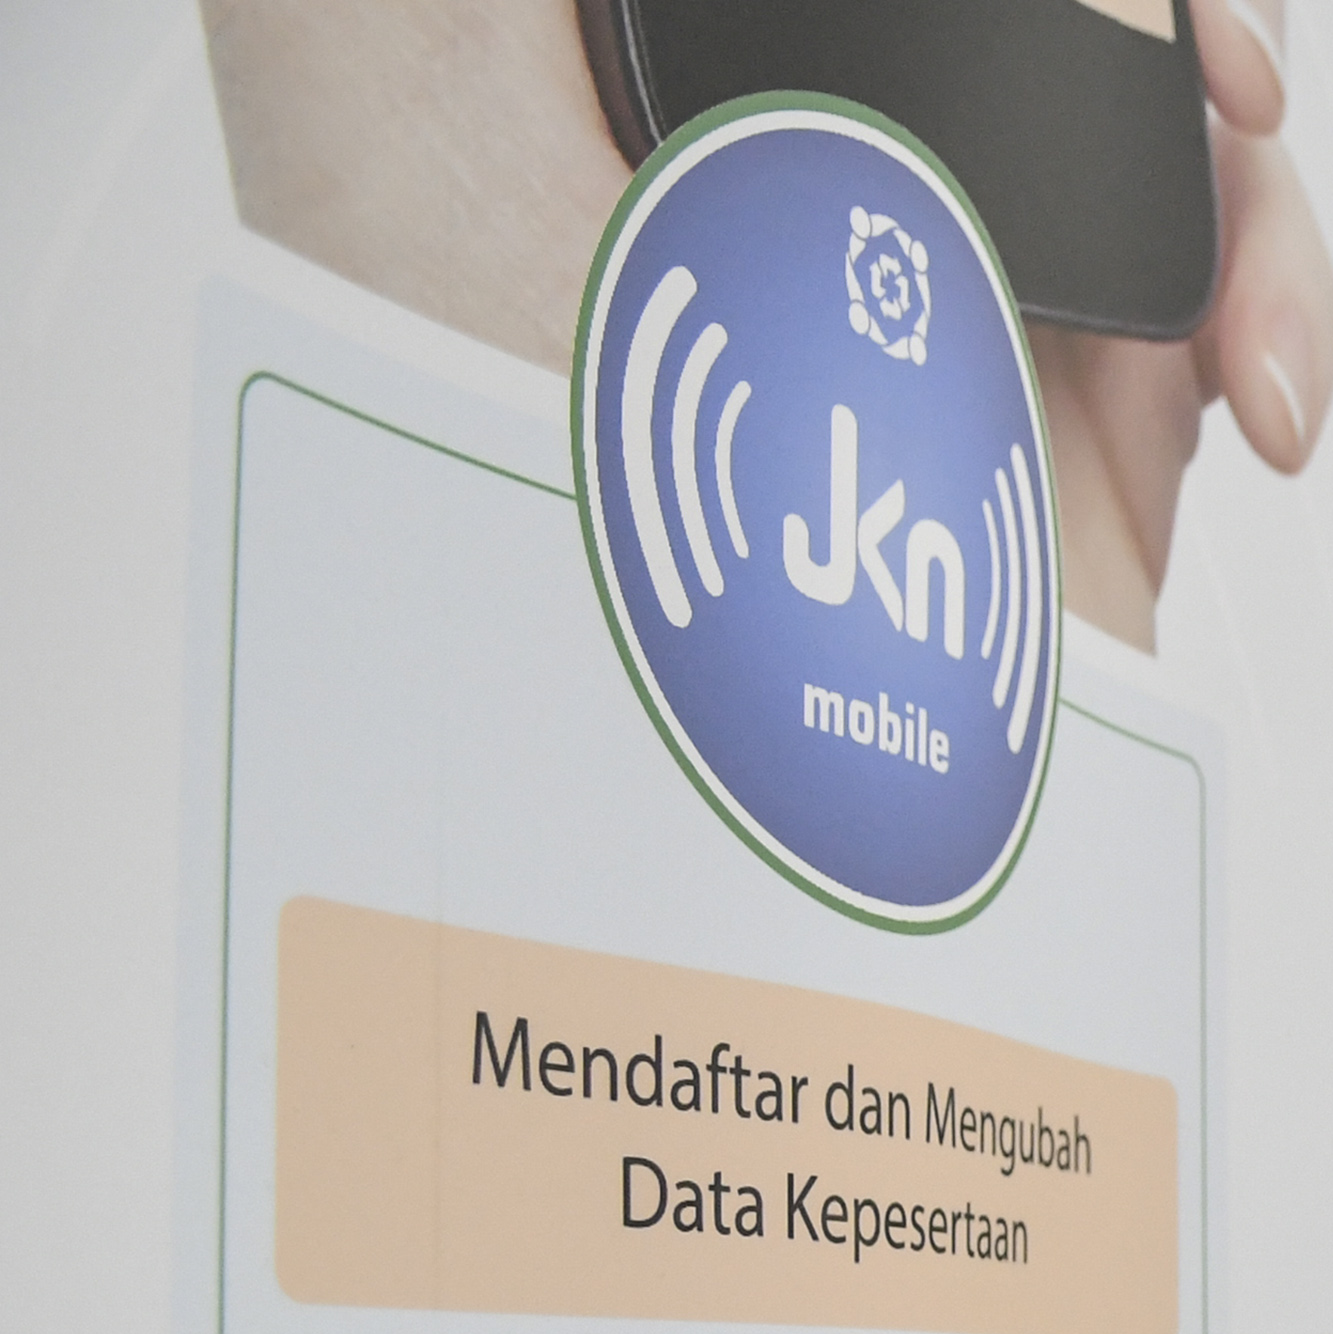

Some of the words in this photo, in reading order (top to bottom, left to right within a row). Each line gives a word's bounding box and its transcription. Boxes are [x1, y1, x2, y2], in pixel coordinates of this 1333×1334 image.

[803, 681, 950, 775] mobile
[471, 1009, 810, 1125] Mendaftar
[823, 1062, 912, 1141] dan
[924, 1081, 1092, 1178] Mengubah
[621, 1155, 765, 1238] Data
[786, 1171, 1029, 1265] Kepesertaan
